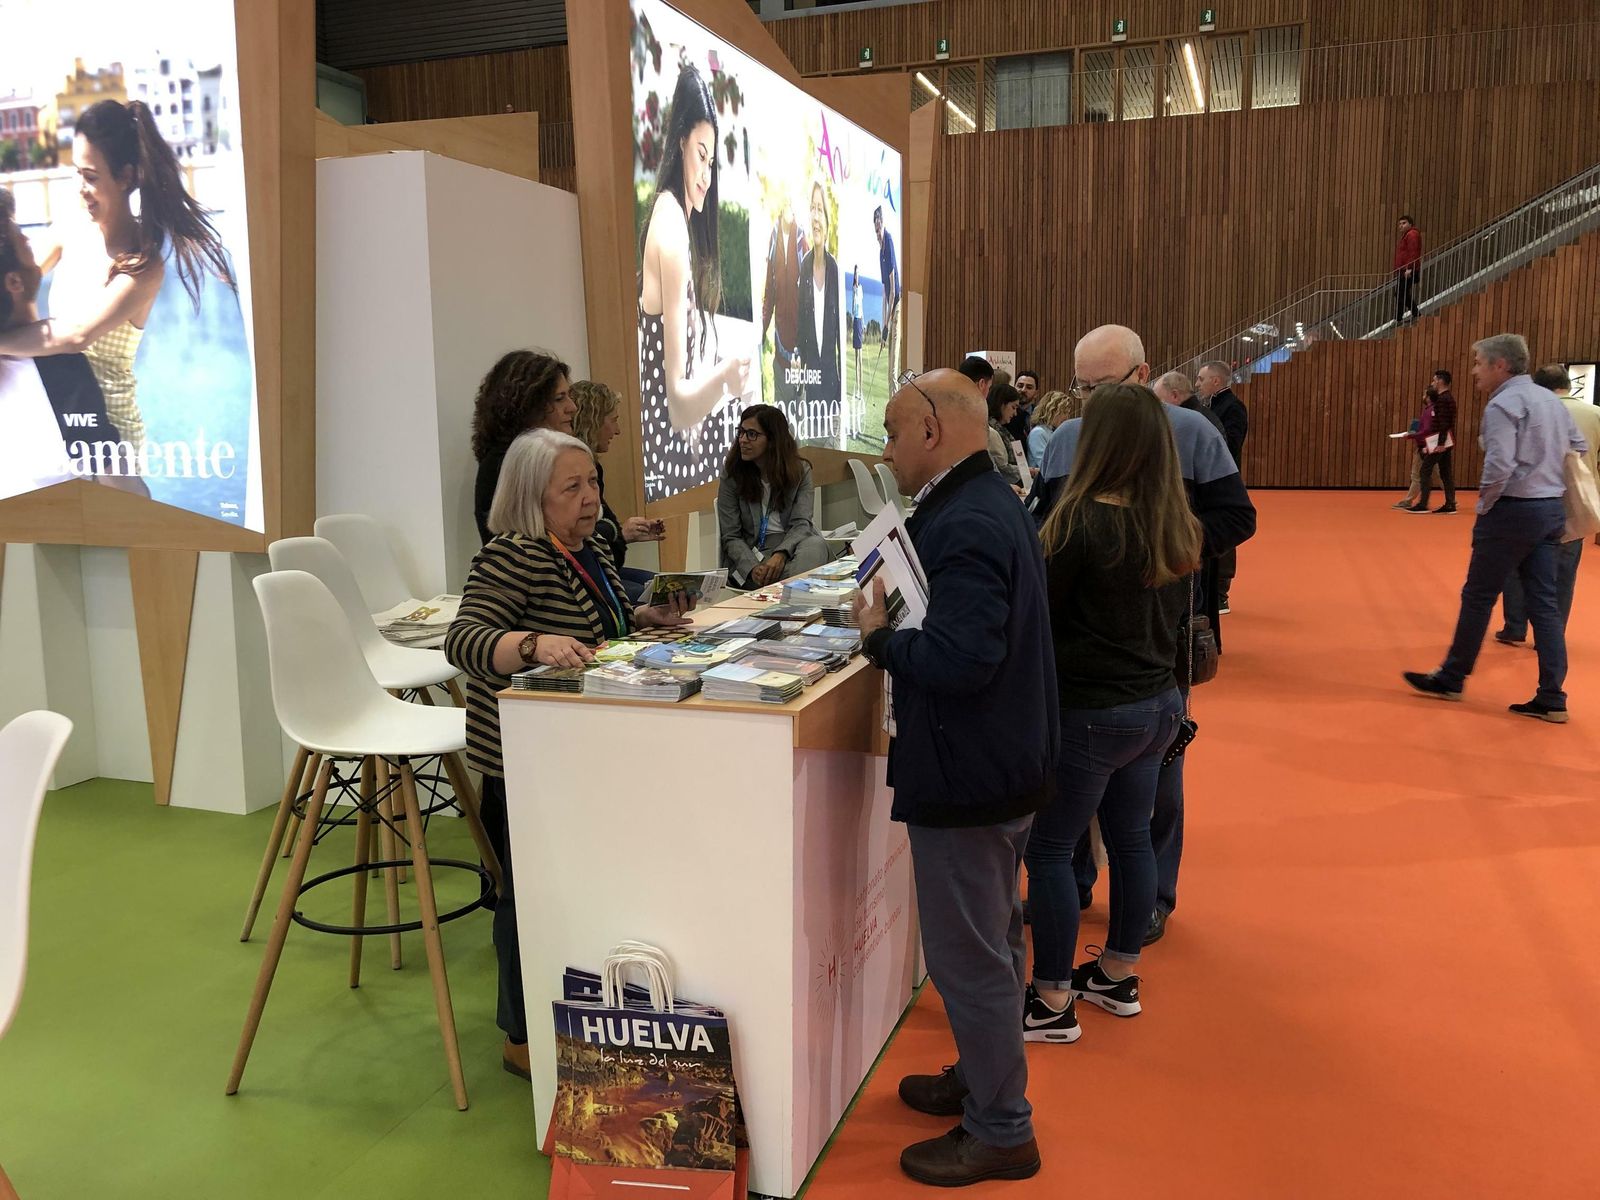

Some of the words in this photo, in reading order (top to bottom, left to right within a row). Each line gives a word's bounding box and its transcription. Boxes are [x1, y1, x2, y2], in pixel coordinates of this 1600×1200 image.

[784, 368, 821, 385] DESCUBRE
[62, 413, 98, 427] VIVE
[58, 426, 236, 479] amente
[854, 915, 878, 958] HUELVA
[581, 1016, 715, 1053] HUELVA
[600, 1048, 615, 1063] la
[649, 1052, 668, 1067] del
[673, 1059, 701, 1071] sur
